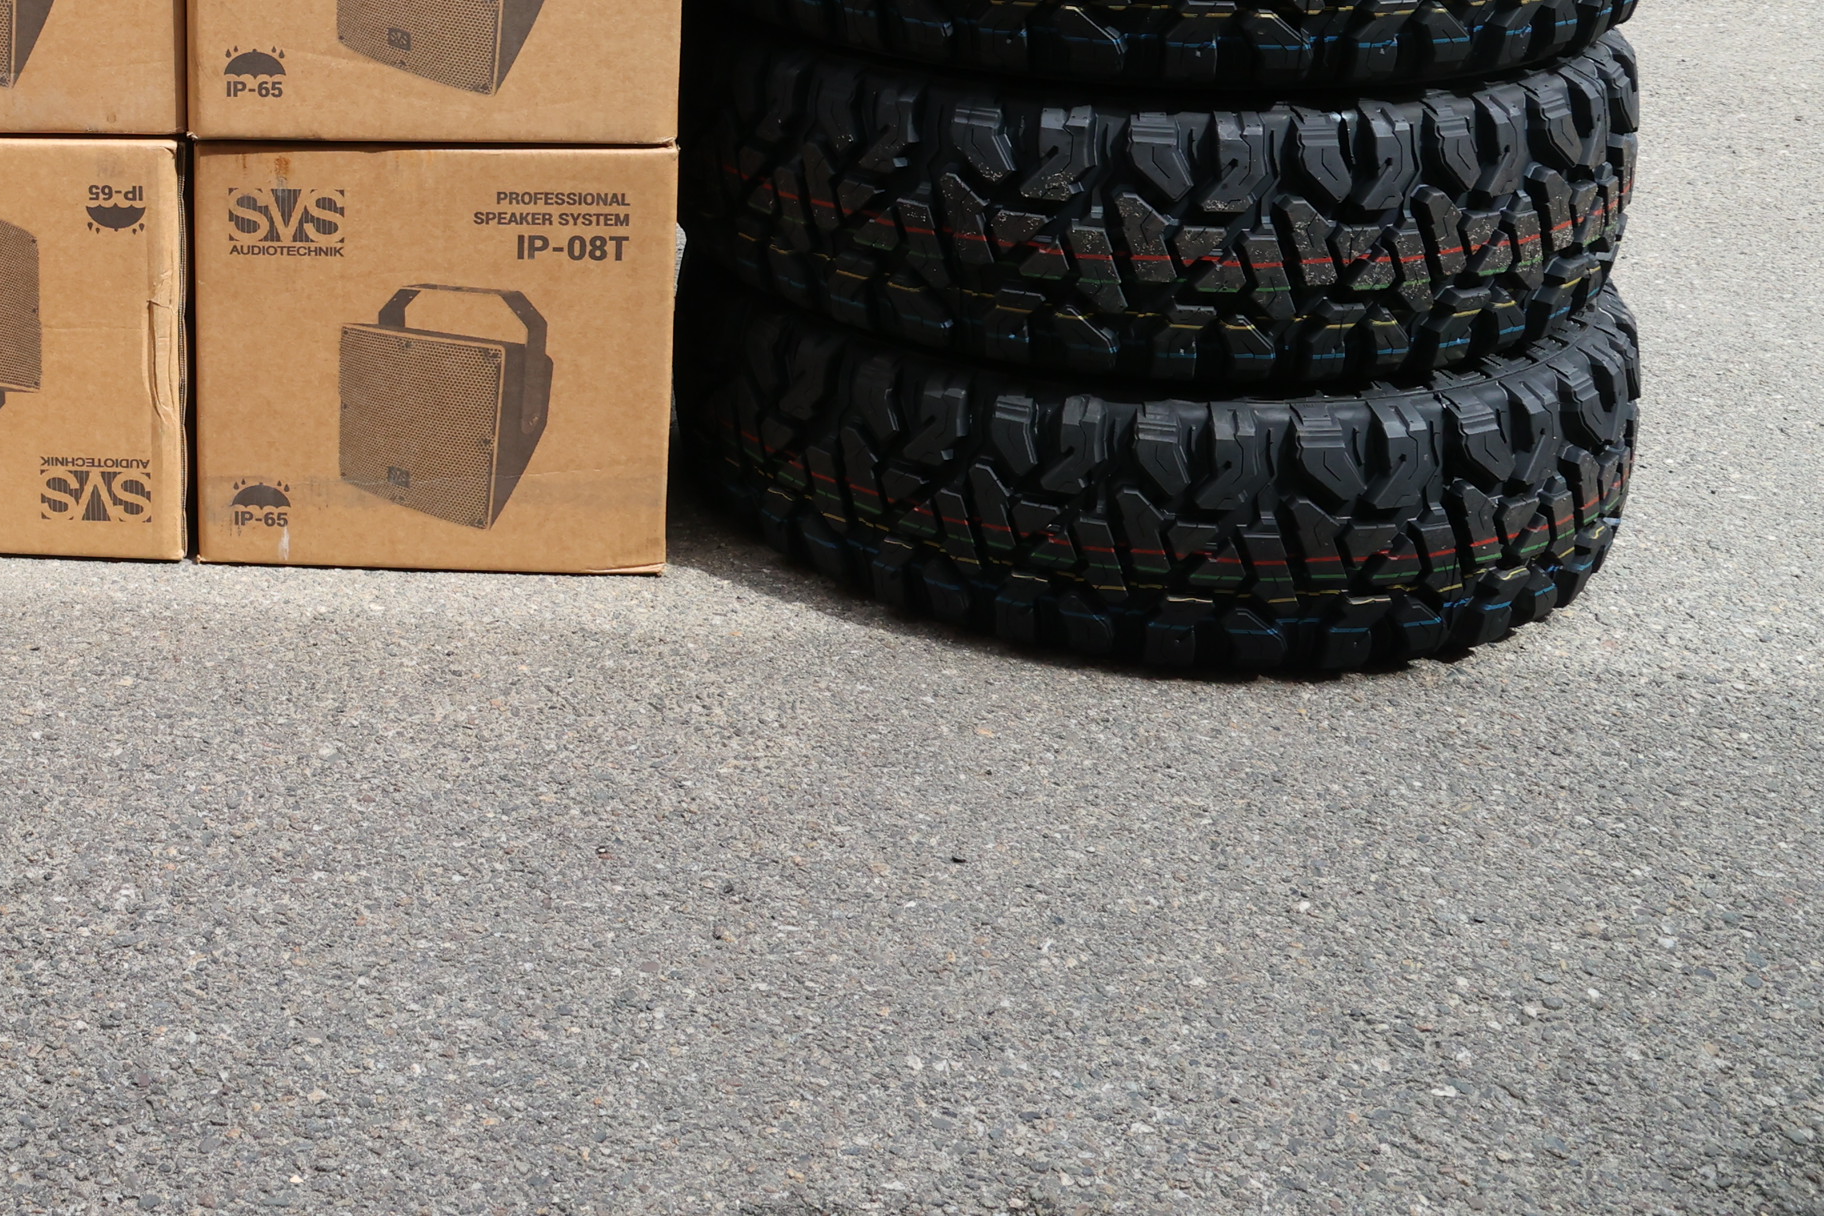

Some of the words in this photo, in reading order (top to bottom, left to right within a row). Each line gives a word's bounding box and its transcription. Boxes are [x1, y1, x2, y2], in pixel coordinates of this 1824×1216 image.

[226, 81, 283, 98] IP-65
[88, 184, 144, 202] IP-65
[496, 191, 631, 206] PROFESSIONAL
[228, 188, 345, 243] SVS
[473, 212, 554, 226] SPEAKER
[558, 212, 630, 227] SYSTEM
[229, 245, 344, 258] AUDIOTECHNIK
[517, 235, 630, 262] IP-08T
[40, 456, 150, 469] AUDIOTECHNIK
[40, 469, 152, 523] SVS
[234, 511, 288, 528] IP-65
